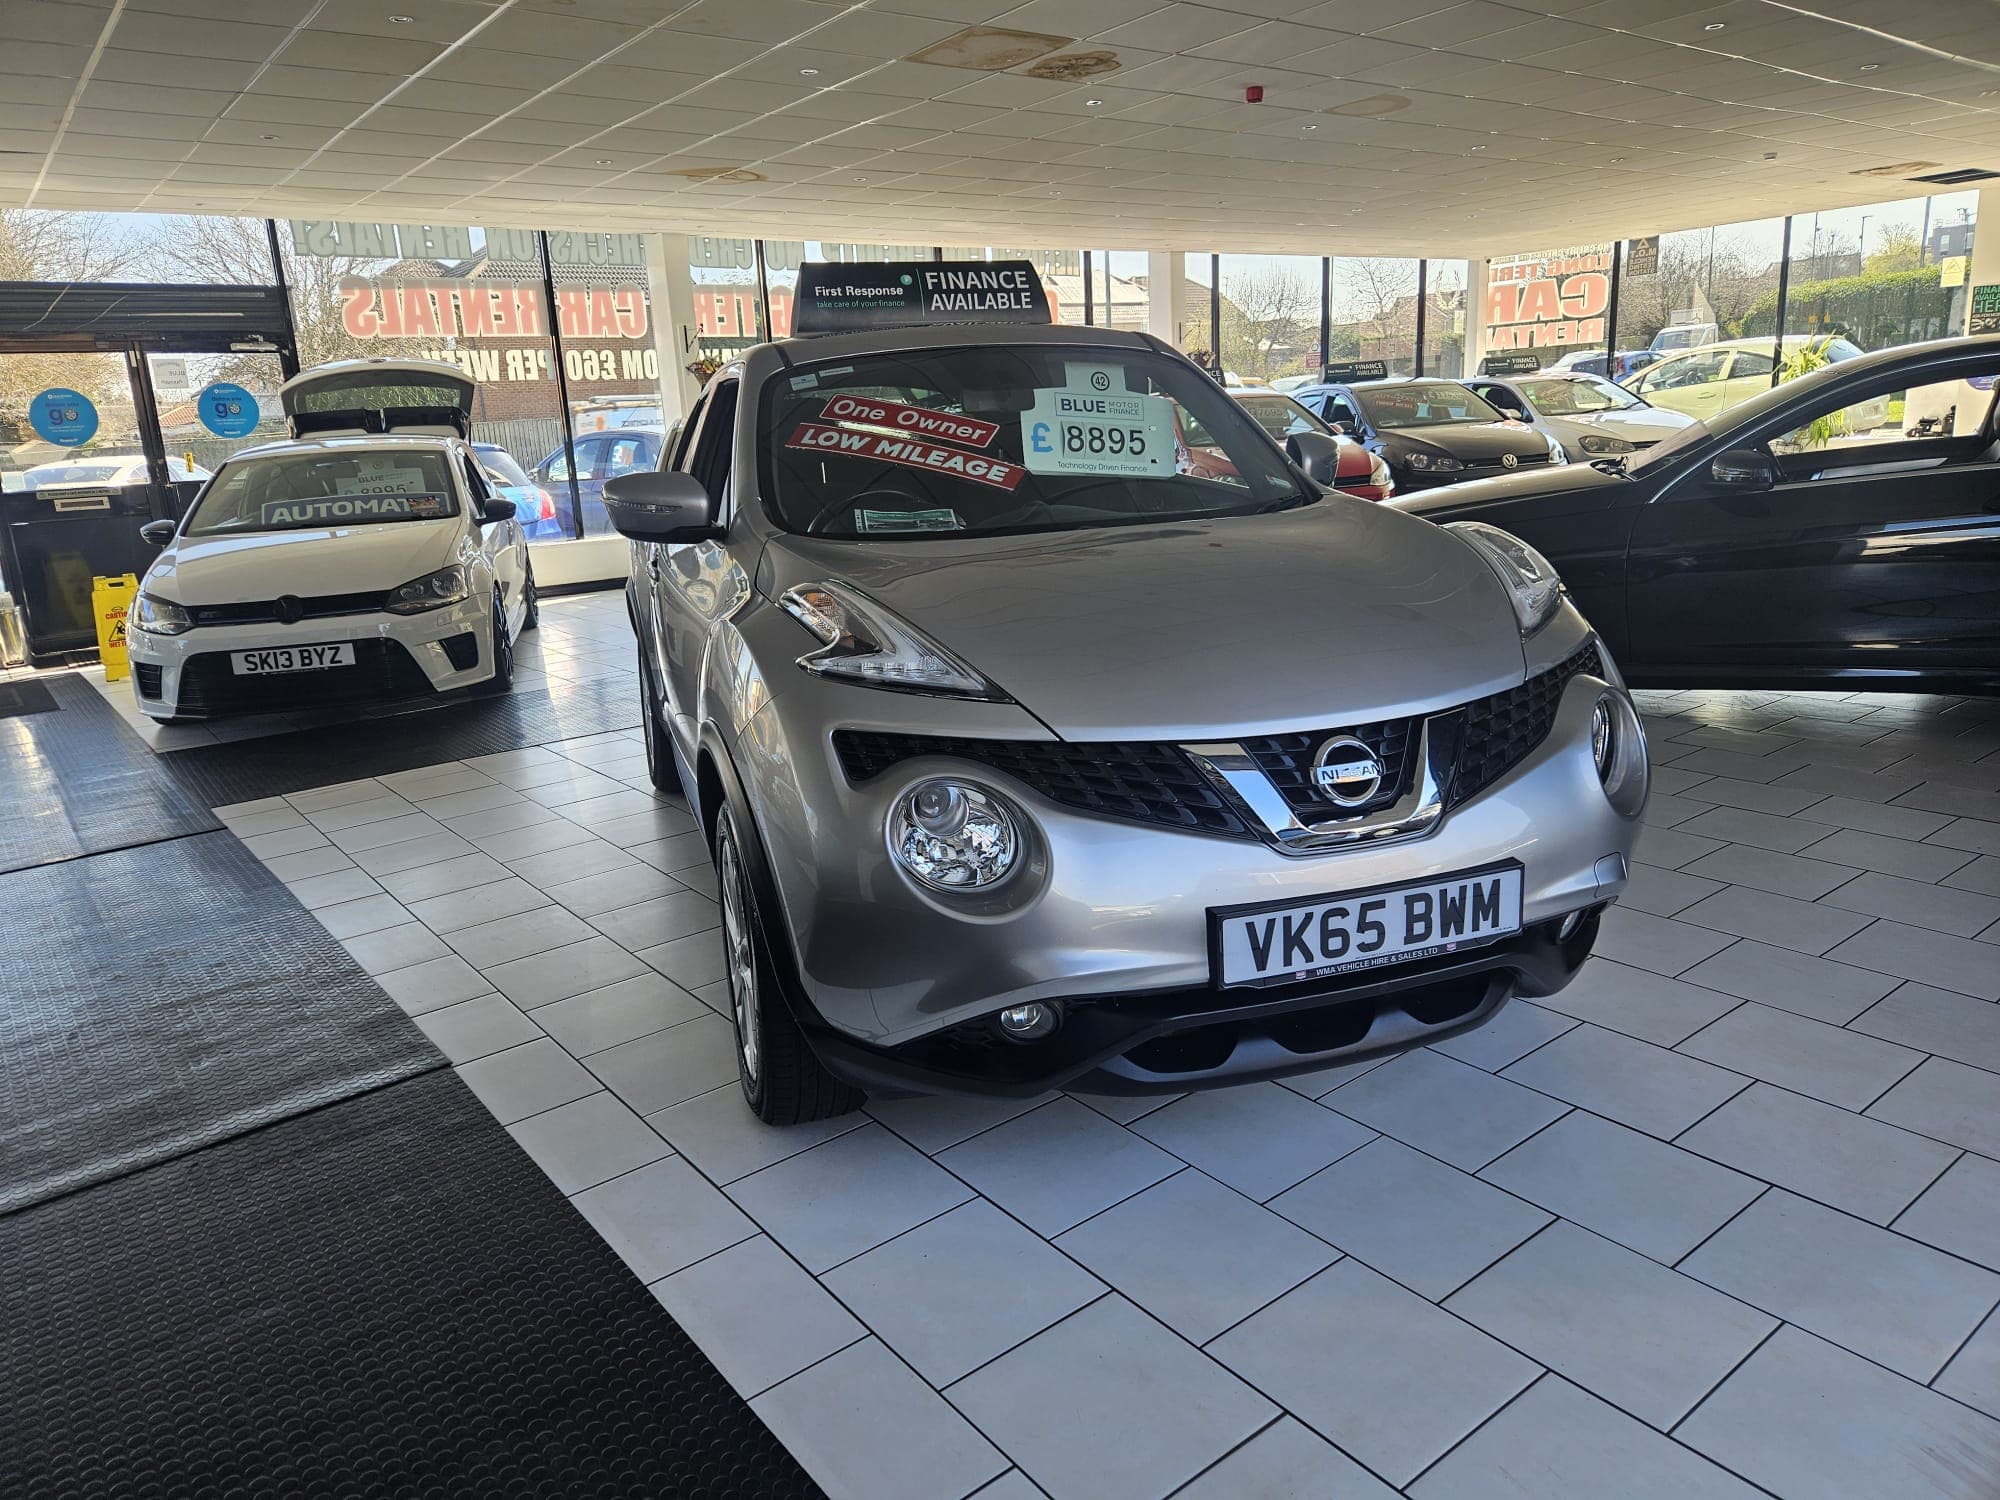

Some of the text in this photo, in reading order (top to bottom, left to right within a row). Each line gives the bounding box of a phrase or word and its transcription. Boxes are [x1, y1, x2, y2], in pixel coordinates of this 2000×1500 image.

[925, 271, 1030, 291] FINANCE
[815, 285, 904, 299] First Response
[1974, 285, 2000, 295] FINA
[860, 301, 878, 309] your
[931, 292, 1033, 311] AVAILABLE
[1973, 300, 2000, 313] HE
[1355, 362, 1384, 371] FINANCE
[1356, 368, 1385, 377] AVAILABLE
[1095, 376, 1106, 387] 42
[1060, 398, 1106, 414] BLUE
[1108, 401, 1140, 409] MOTOR
[1109, 408, 1140, 416] FINANCE
[833, 399, 988, 441] One Owner
[1030, 422, 1146, 456] £ 8895
[801, 428, 1011, 483] LOW MILEAGE
[1057, 460, 1148, 473] Technology Driven Finance
[271, 497, 440, 525] AUTOMAT
[105, 611, 128, 620] CAUTIO
[244, 645, 343, 672] SK13 BYZ
[1245, 878, 1502, 972] VK65 BWM
[1316, 967, 1337, 976] WMA
[1337, 960, 1370, 973] VEHICLE
[1371, 957, 1390, 966] HIRE
[1398, 951, 1423, 961] SALES
[1423, 947, 1438, 956] LTD
